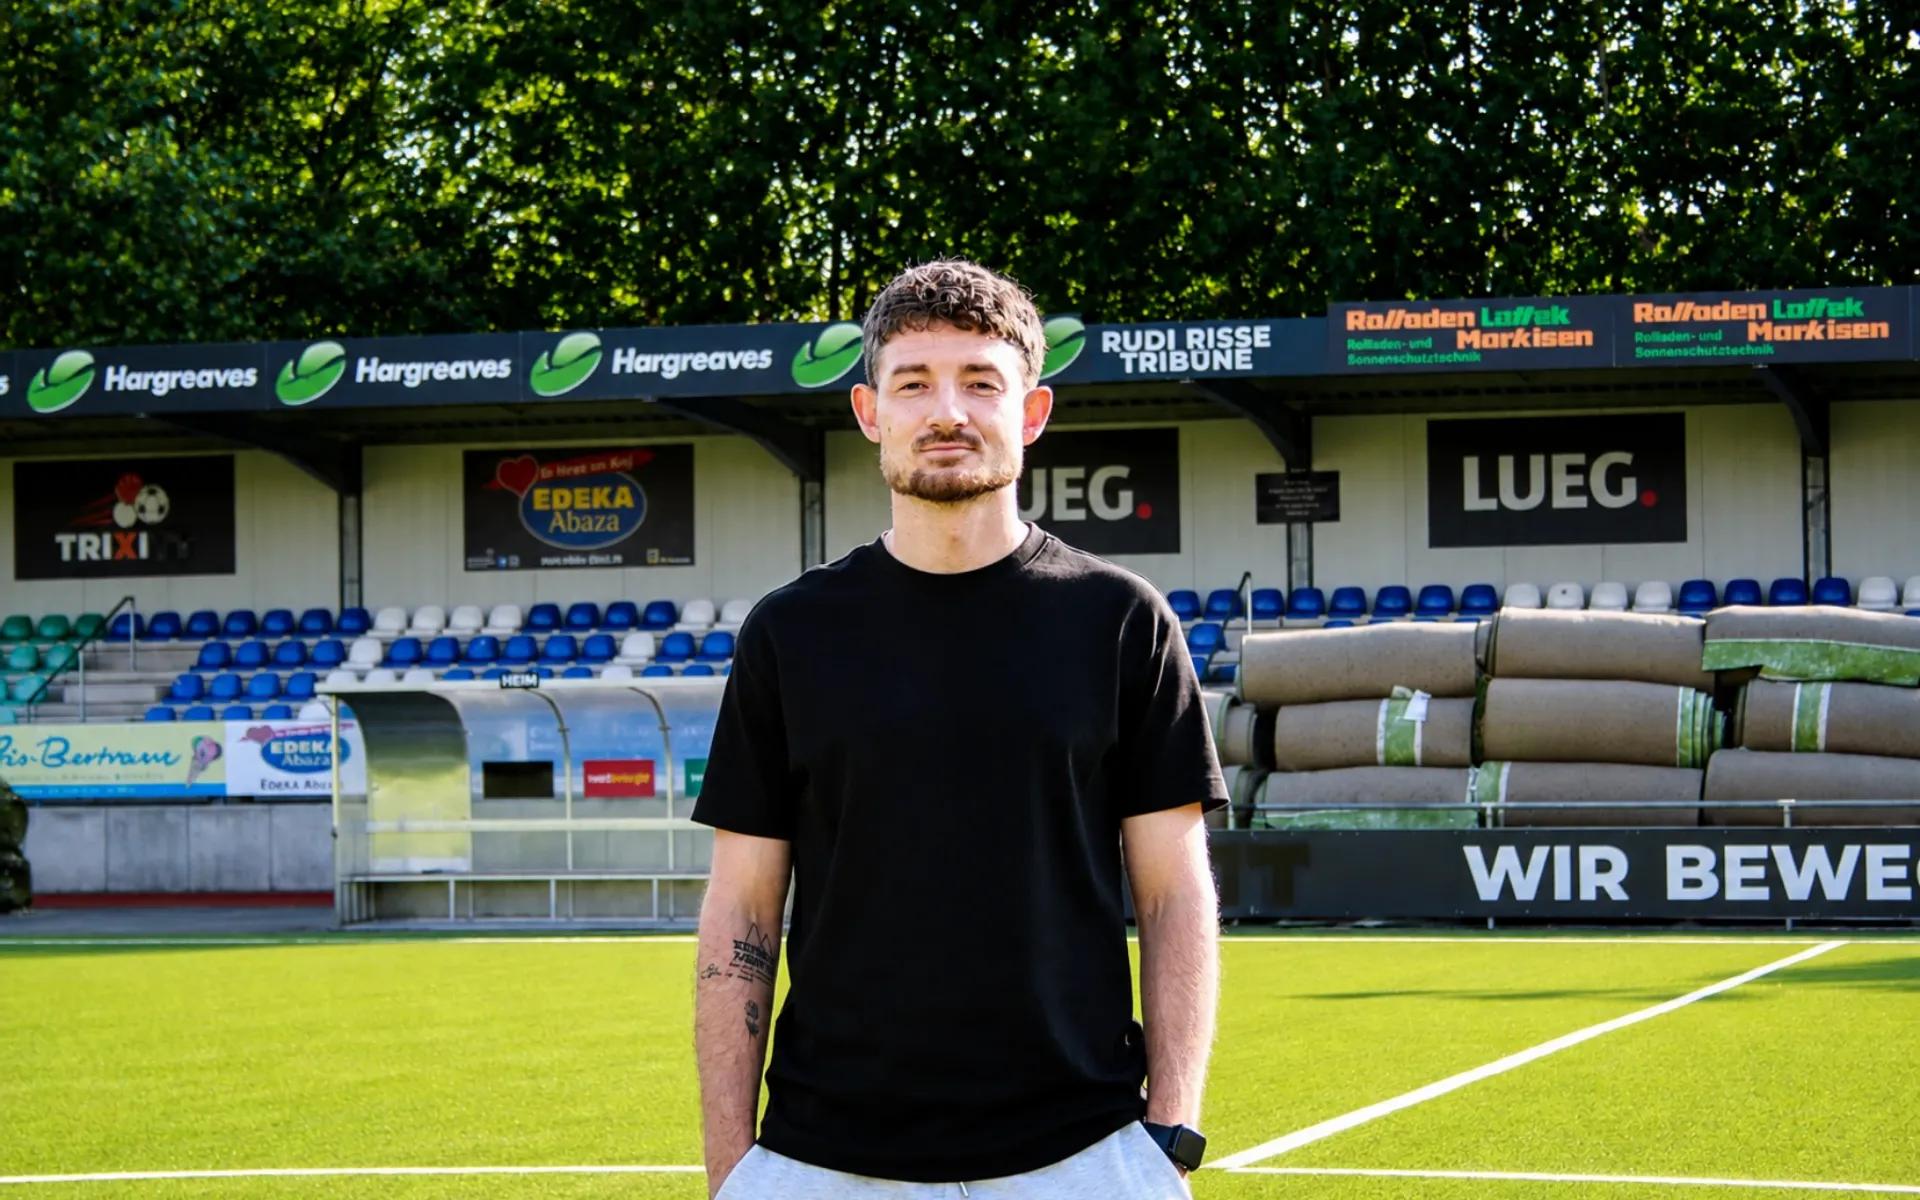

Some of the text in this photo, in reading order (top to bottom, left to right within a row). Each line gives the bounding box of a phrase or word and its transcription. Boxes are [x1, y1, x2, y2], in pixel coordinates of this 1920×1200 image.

[1102, 325, 1272, 353] RUDI RISSE
[1456, 327, 1594, 349] Markisen
[1699, 330, 1722, 341] und
[1747, 319, 1890, 342] Markisen
[1409, 337, 1433, 349] und
[355, 356, 512, 389] Hargreaves
[610, 347, 773, 380] Hargreaves
[1119, 349, 1254, 373] TRIBÜNE
[104, 364, 258, 397] Hargreaves
[533, 486, 635, 511] EDEKA
[1017, 465, 1154, 521] UEG.
[549, 512, 621, 534] Abaza
[502, 674, 538, 688] HEIM
[260, 779, 299, 790] EDEKA
[1464, 845, 1920, 901] WIR BEWE
